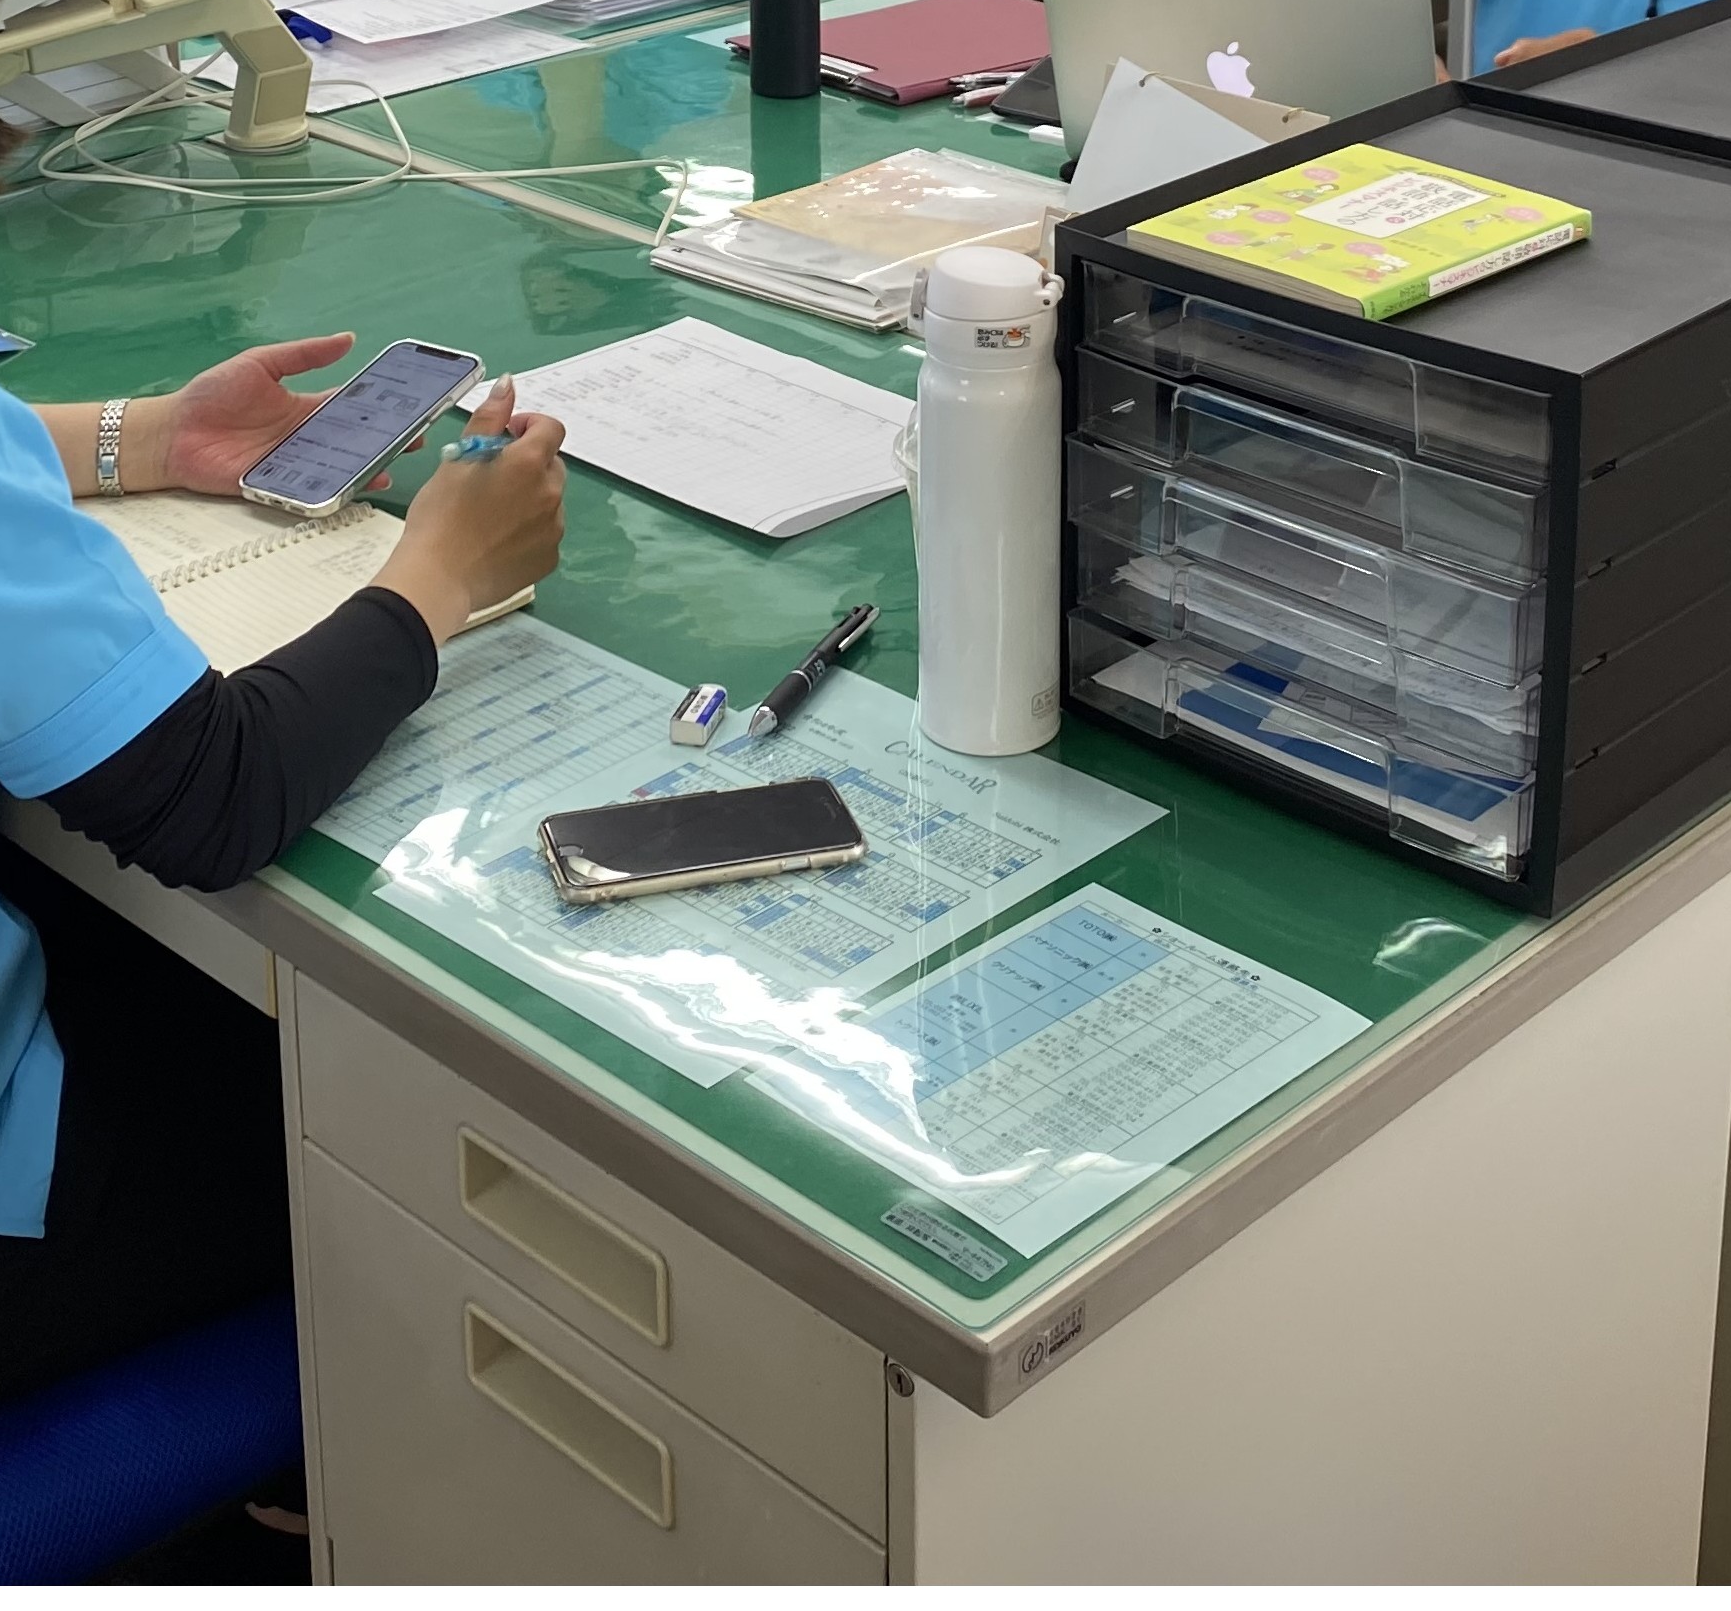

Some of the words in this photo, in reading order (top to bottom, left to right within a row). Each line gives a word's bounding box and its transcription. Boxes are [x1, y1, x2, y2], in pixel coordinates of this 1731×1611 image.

[880, 738, 1000, 795] CALENDAR
[1020, 825, 1063, 846] 株式会社
[1049, 1324, 1082, 1356] KOKUYO
